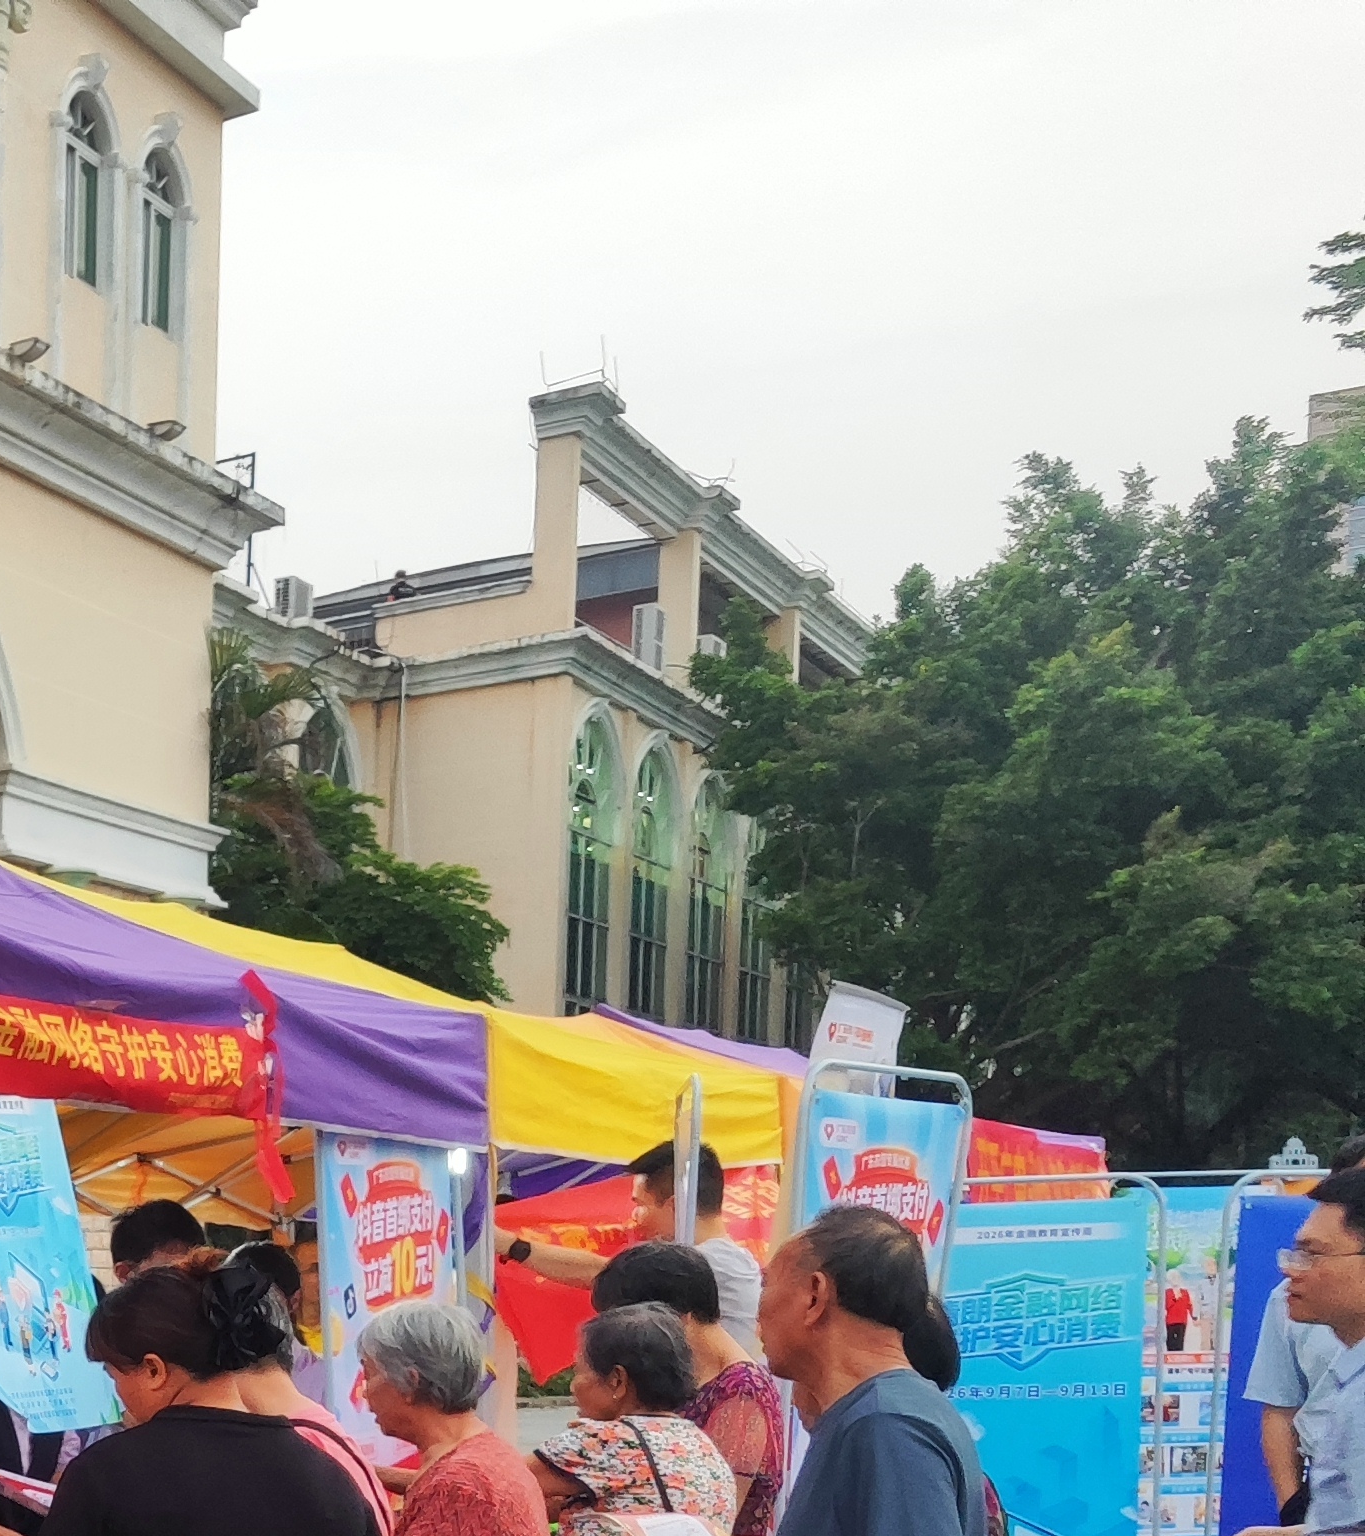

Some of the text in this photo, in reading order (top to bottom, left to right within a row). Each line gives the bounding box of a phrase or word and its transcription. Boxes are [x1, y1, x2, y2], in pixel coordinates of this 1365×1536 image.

[956, 1312, 1122, 1354] 护安心消费
